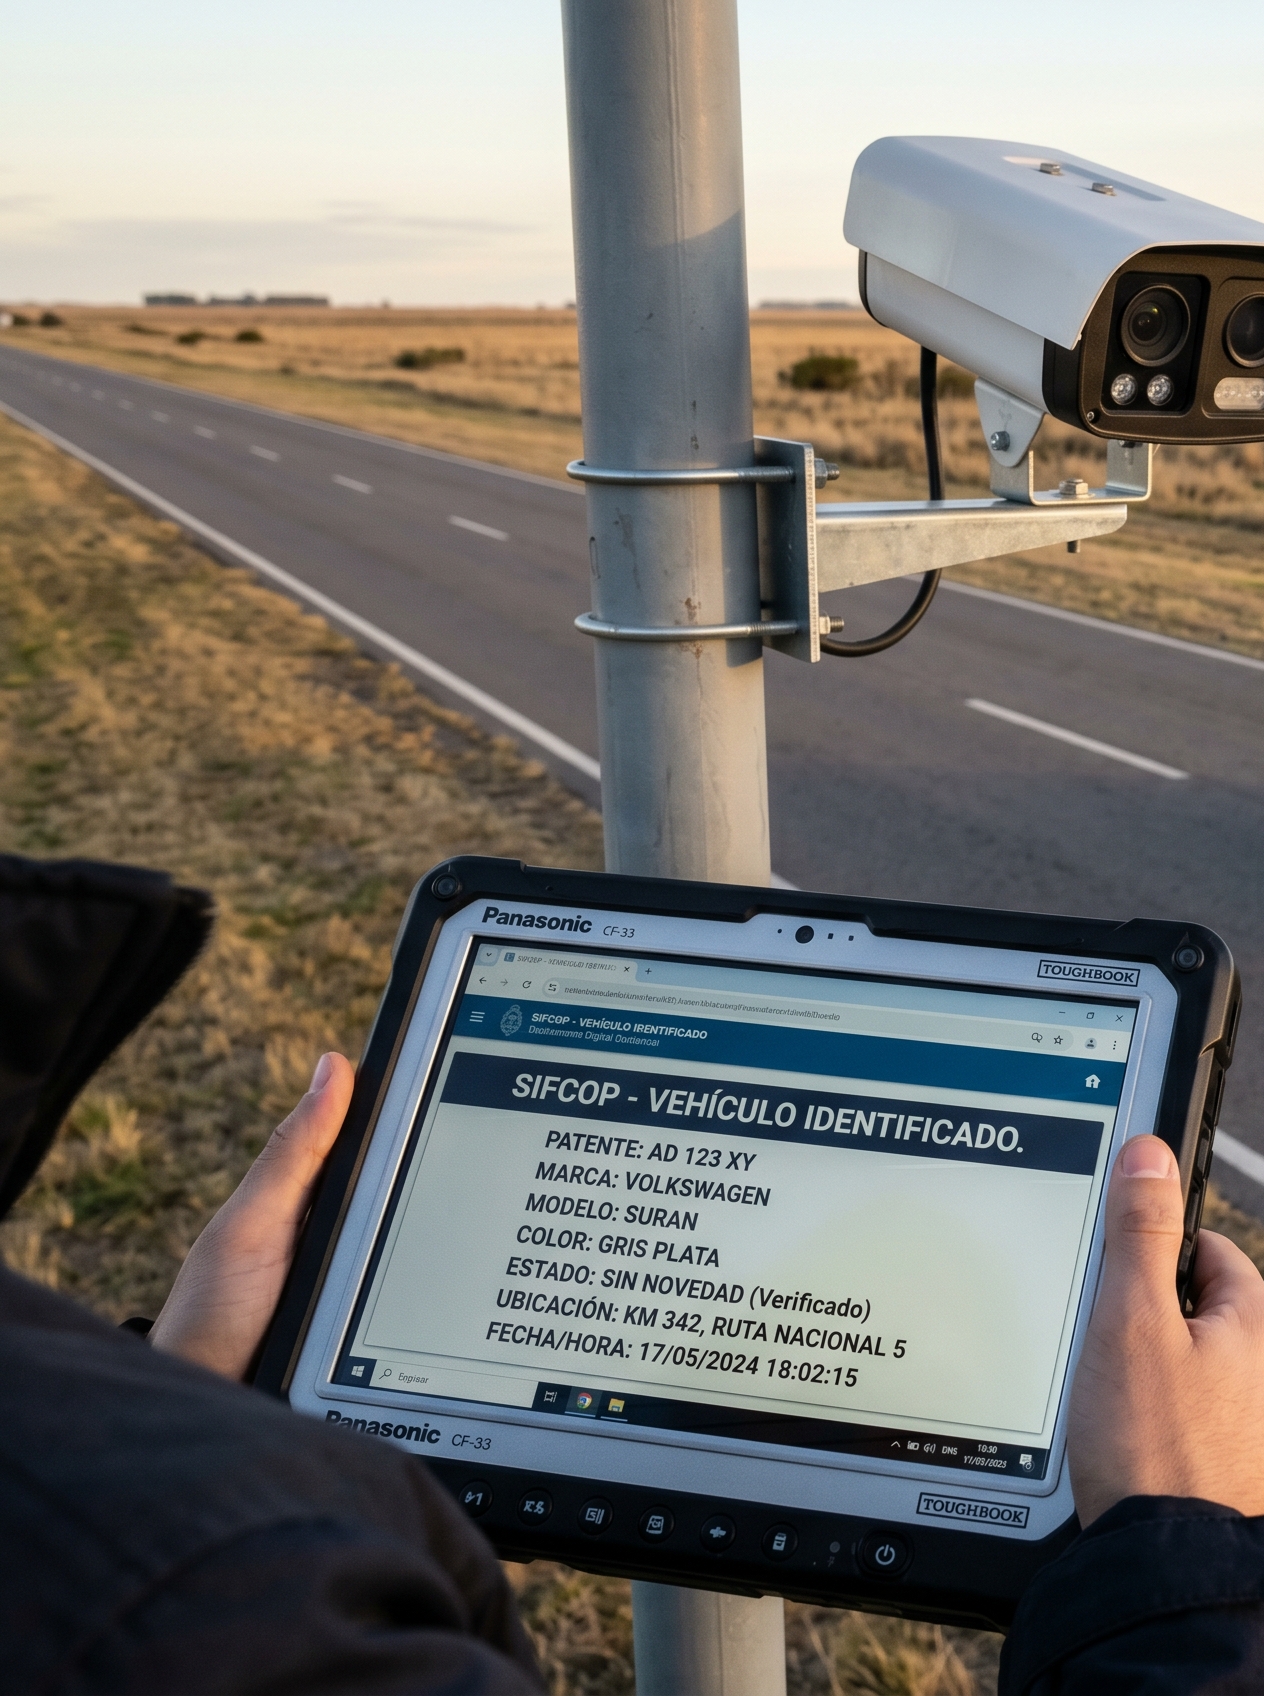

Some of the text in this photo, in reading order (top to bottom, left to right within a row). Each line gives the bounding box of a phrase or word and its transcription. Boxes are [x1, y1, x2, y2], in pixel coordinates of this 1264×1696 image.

[481, 906, 636, 939] Panasonic CF-33
[1042, 963, 1136, 984] TOUGHBOOK
[531, 1013, 570, 1025] SIFCOP
[579, 1018, 632, 1032] VEHÍCULO
[512, 1073, 621, 1107] SIFCOP
[649, 1087, 798, 1128] VEHÍCULO
[804, 1105, 1024, 1153] IDENTIFICADO.
[545, 1130, 757, 1172] PATENTE: AD 123 XY
[535, 1162, 771, 1207] MARCA: VOLKSWAGEN
[525, 1193, 698, 1231] MODELO: SURAN
[516, 1225, 720, 1267] COLOR: GRIS PLATA
[506, 1257, 871, 1323] ESTADO: SIN NOVEDAD (Verificado)
[496, 1289, 906, 1359] UBICACIÓN: KM 342, RUTA NACIONAL 5
[486, 1321, 858, 1387] FECHA/HORA: 17/05/2024 18:02:15
[325, 1410, 492, 1450] Panasonic CF-33
[923, 1498, 1024, 1524] TOUGHBOOK
